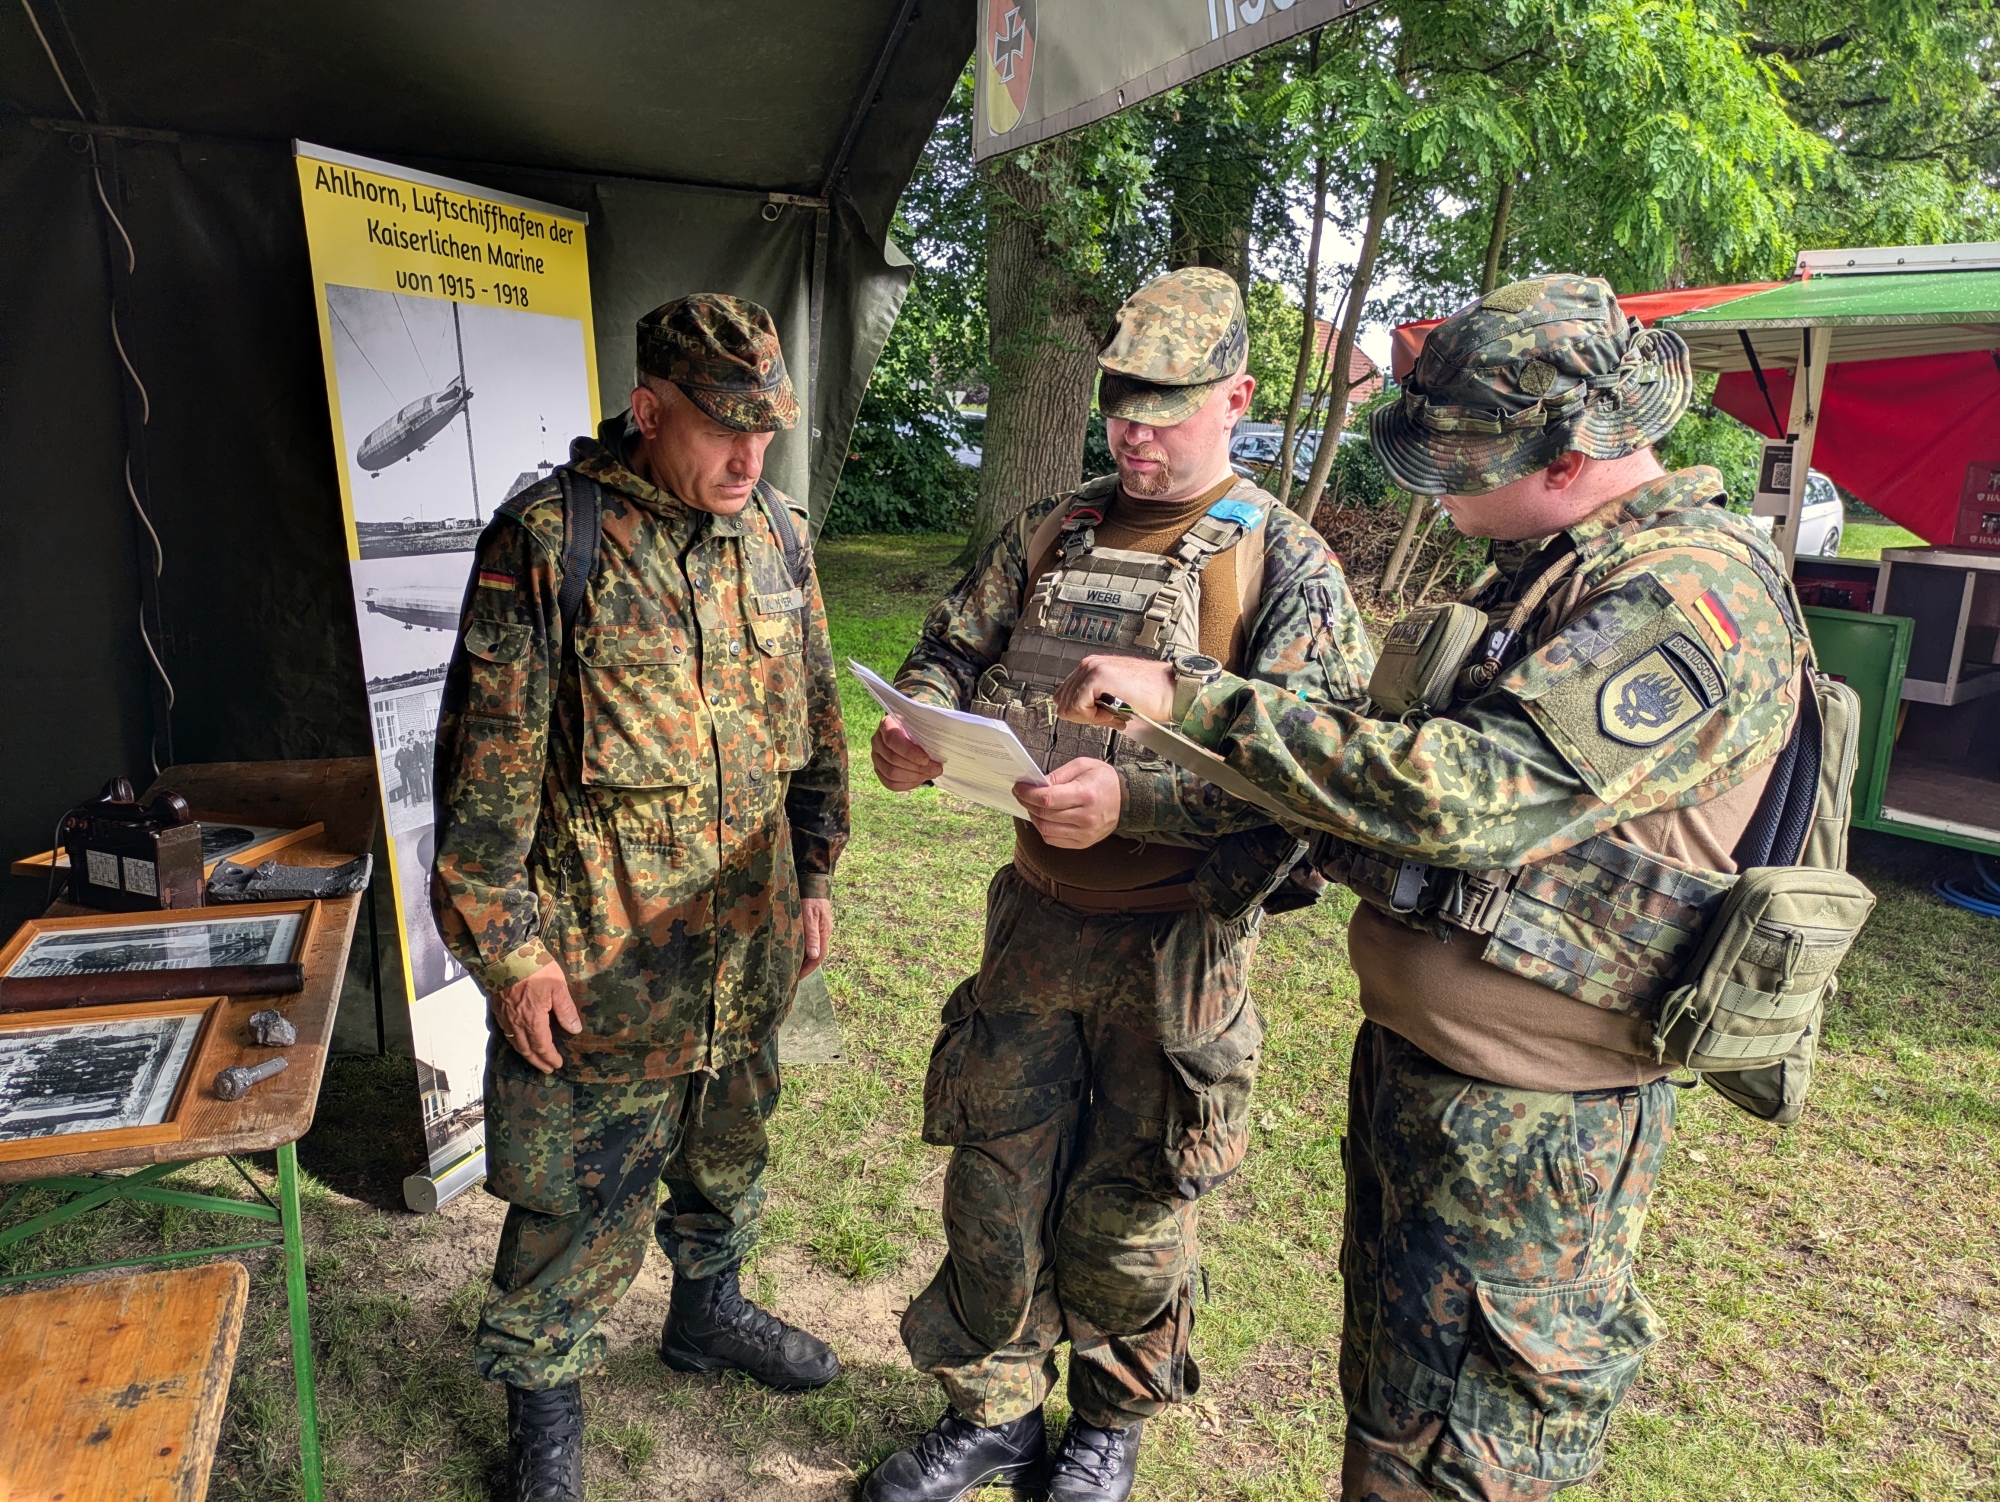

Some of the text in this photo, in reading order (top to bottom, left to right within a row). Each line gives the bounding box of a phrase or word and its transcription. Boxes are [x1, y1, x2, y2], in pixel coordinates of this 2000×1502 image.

[315, 165, 573, 246] Ahlhorn, Luftschiffhafen der
[367, 218, 545, 275] Kaiserlichen Marine
[396, 270, 434, 293] von
[438, 272, 476, 300] 1915
[493, 282, 529, 308] 1918
[1087, 589, 1121, 604] WEBB
[1063, 614, 1116, 642] DEU
[1670, 638, 1722, 698] BRANDSCHUTZ
